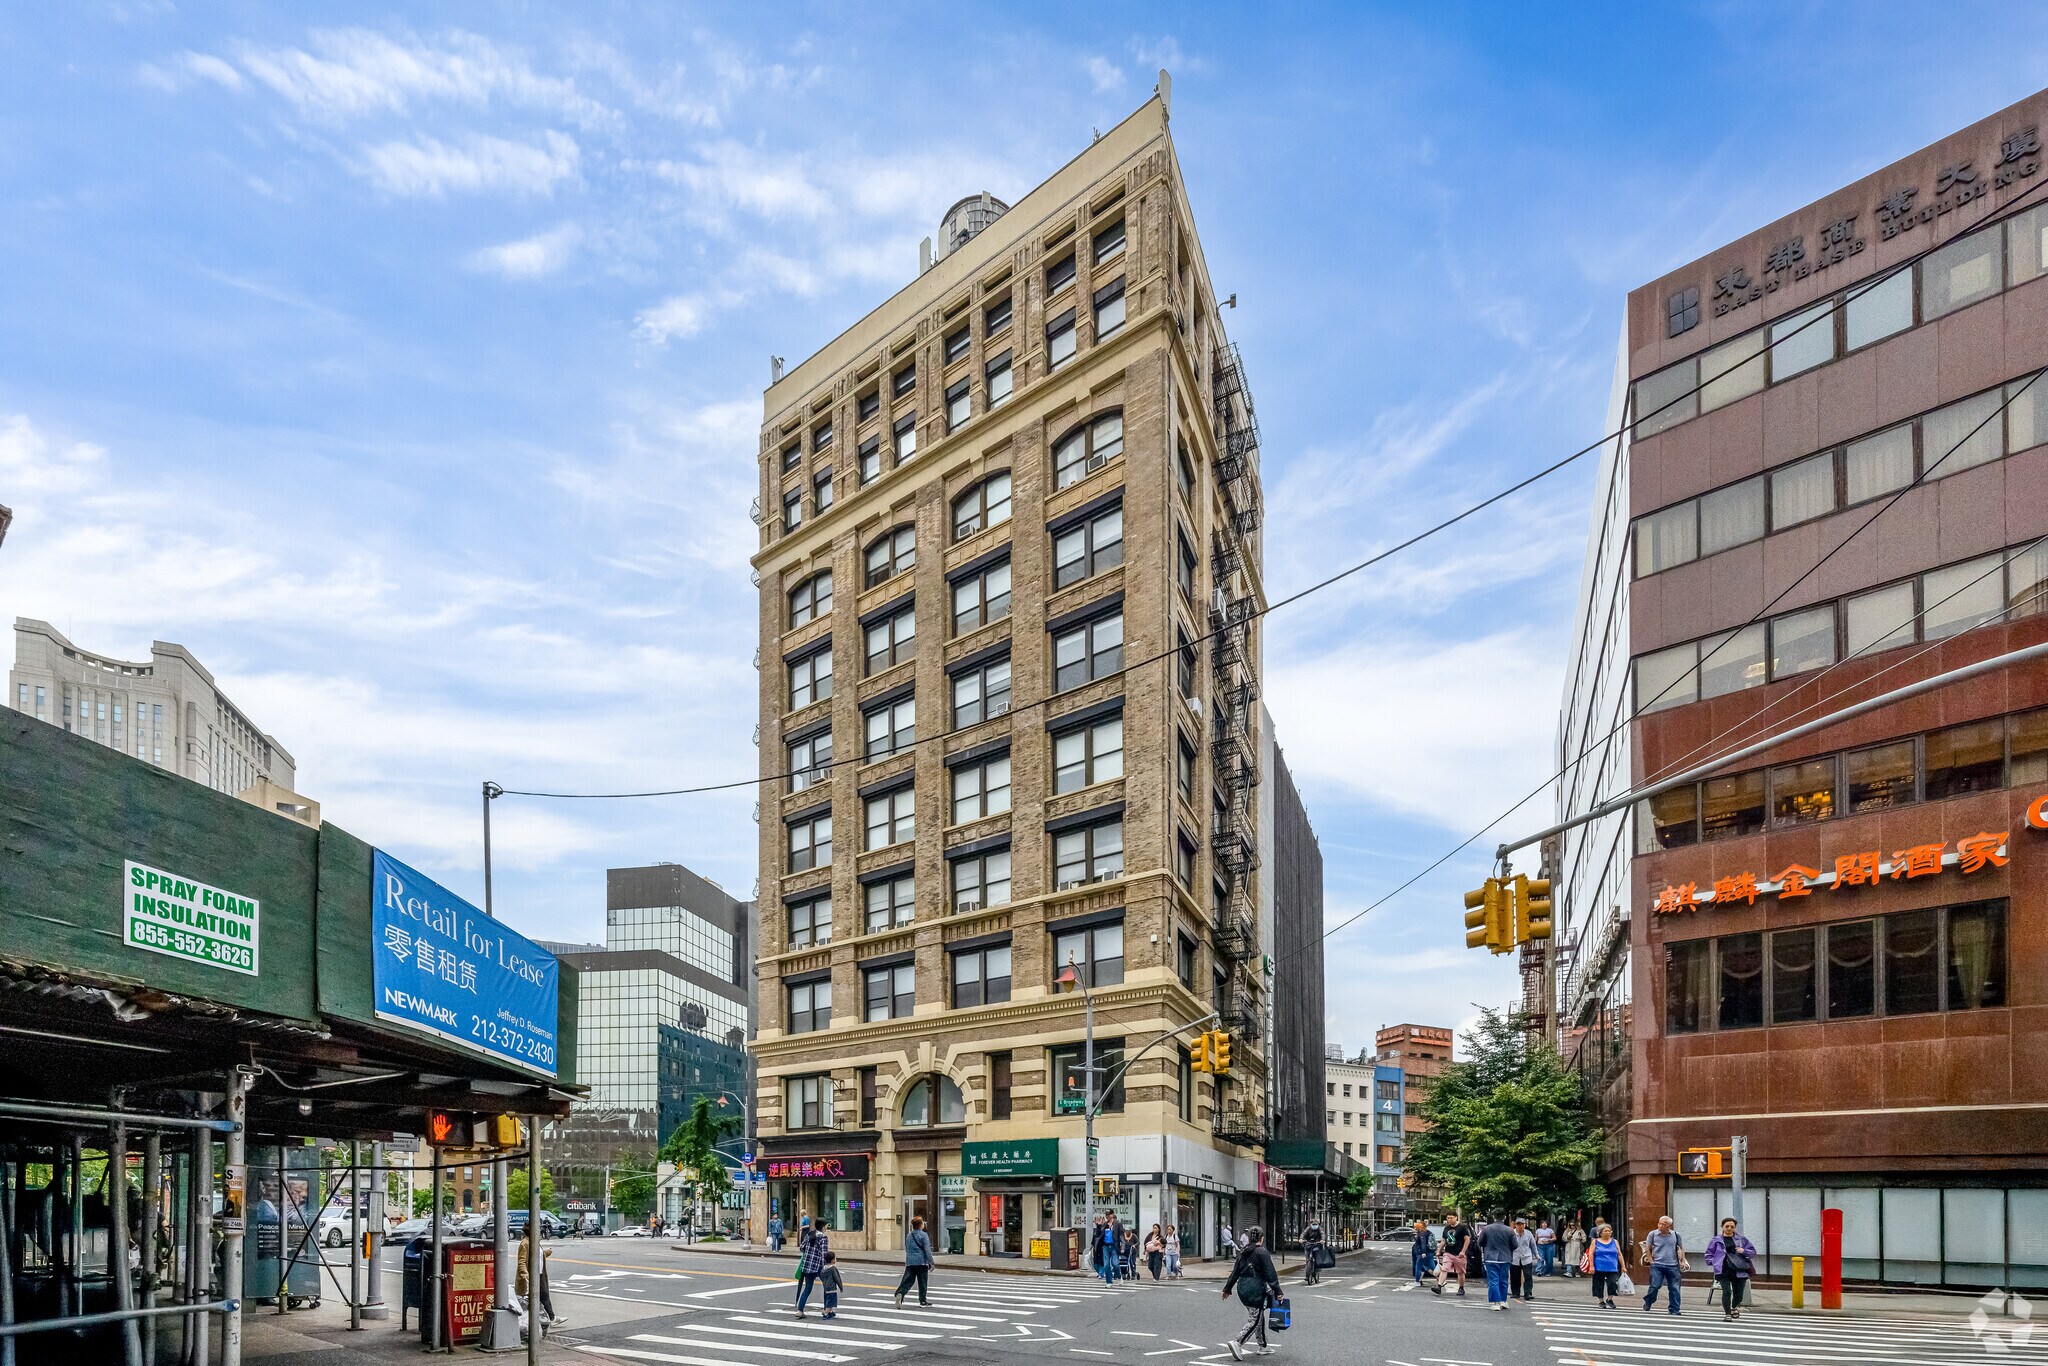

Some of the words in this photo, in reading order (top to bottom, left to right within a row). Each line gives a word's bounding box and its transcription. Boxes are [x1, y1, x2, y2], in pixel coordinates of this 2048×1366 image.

[1715, 279, 1780, 318] EAST
[1795, 240, 1866, 282] BASE
[1882, 162, 2040, 242] BUILDING
[1654, 831, 2010, 914] 麒麟金閣酒家
[131, 867, 198, 902] SPRAY
[203, 888, 254, 920] FOAM
[134, 893, 251, 942] INSULATION
[384, 872, 458, 941] Retail
[464, 919, 494, 960] for
[498, 937, 544, 987] Lease
[134, 921, 250, 967] 855-552-3626
[384, 923, 478, 995] 零售租赁
[385, 987, 458, 1028] NEWMARK
[497, 1008, 519, 1028] Jeffrey
[520, 1016, 526, 1028] D.
[527, 1020, 553, 1041] Roseman
[472, 1015, 554, 1065] 212-372-2430
[1383, 1100, 1392, 1110] 4
[566, 1200, 597, 1210] citibank
[880, 1187, 886, 1197] 2
[1115, 1188, 1134, 1205] RENT
[454, 1295, 473, 1303] SHOW
[454, 1302, 484, 1316] LOVE
[463, 1314, 484, 1323] CLEAN
